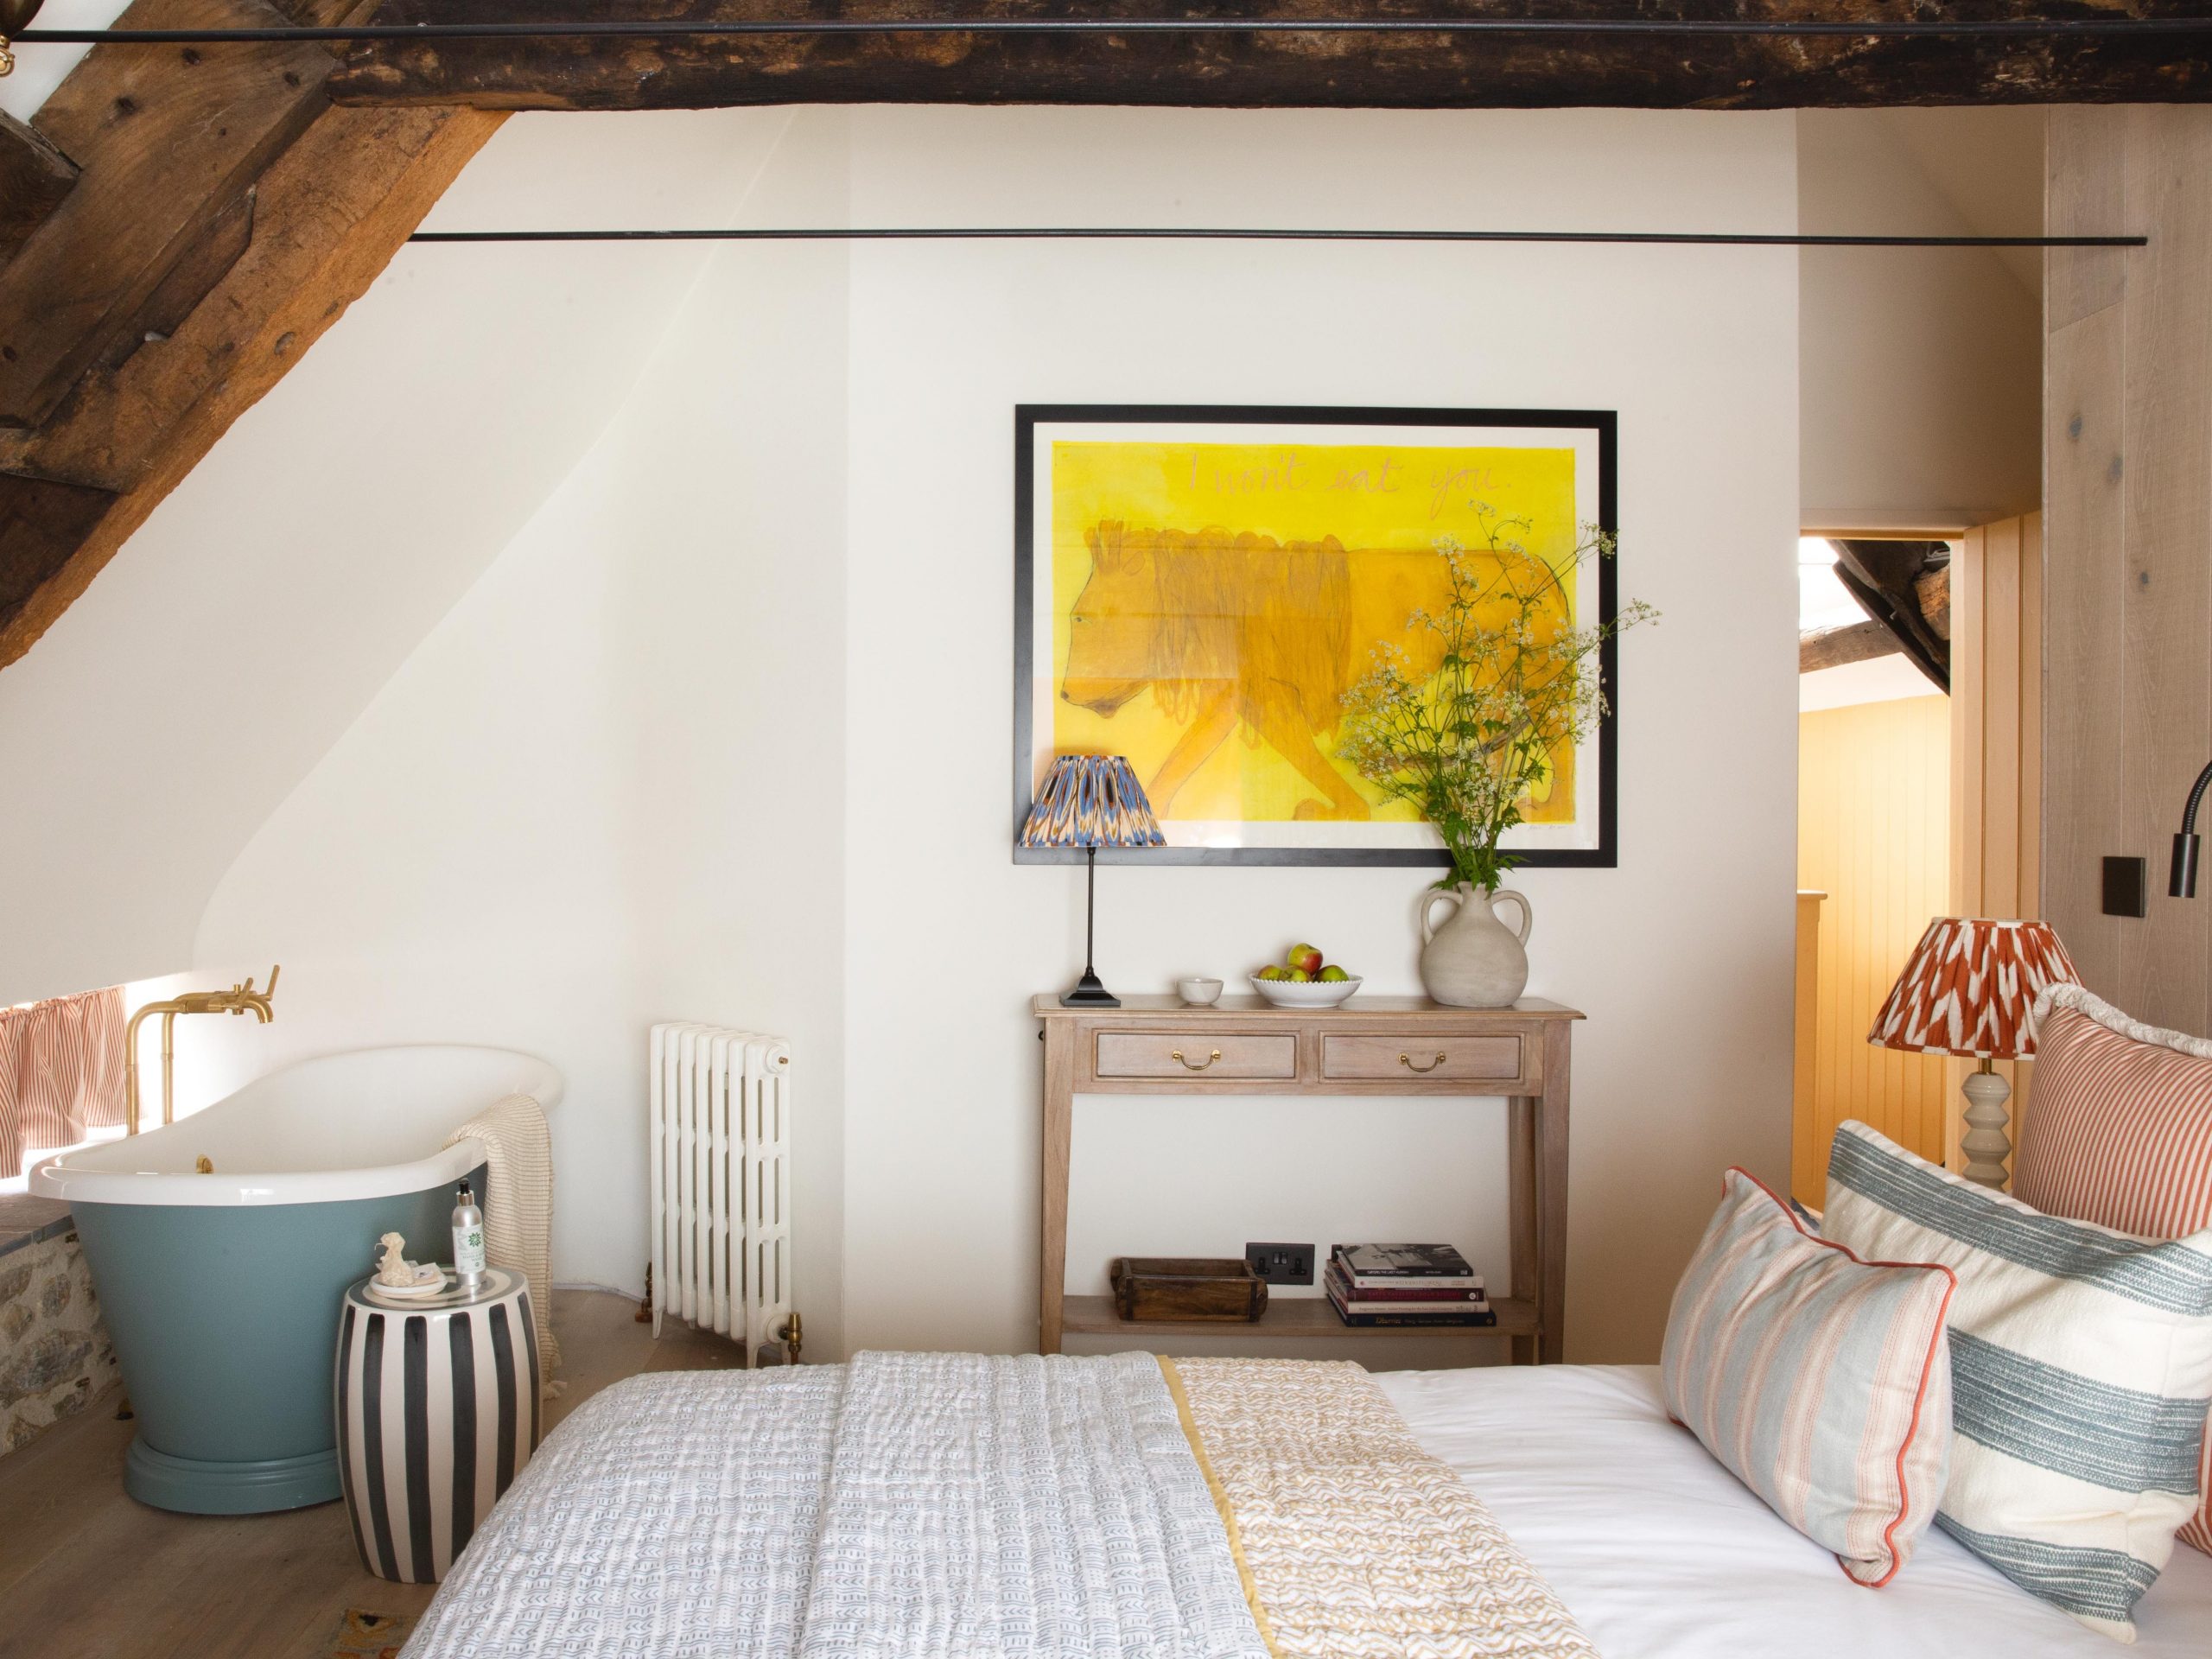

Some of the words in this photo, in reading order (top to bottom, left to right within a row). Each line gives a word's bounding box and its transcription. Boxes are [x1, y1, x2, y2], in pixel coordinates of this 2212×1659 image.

[1190, 451, 1198, 492] I
[1215, 452, 1310, 494] won't
[1325, 455, 1404, 493] eat
[1429, 465, 1512, 521] you.
